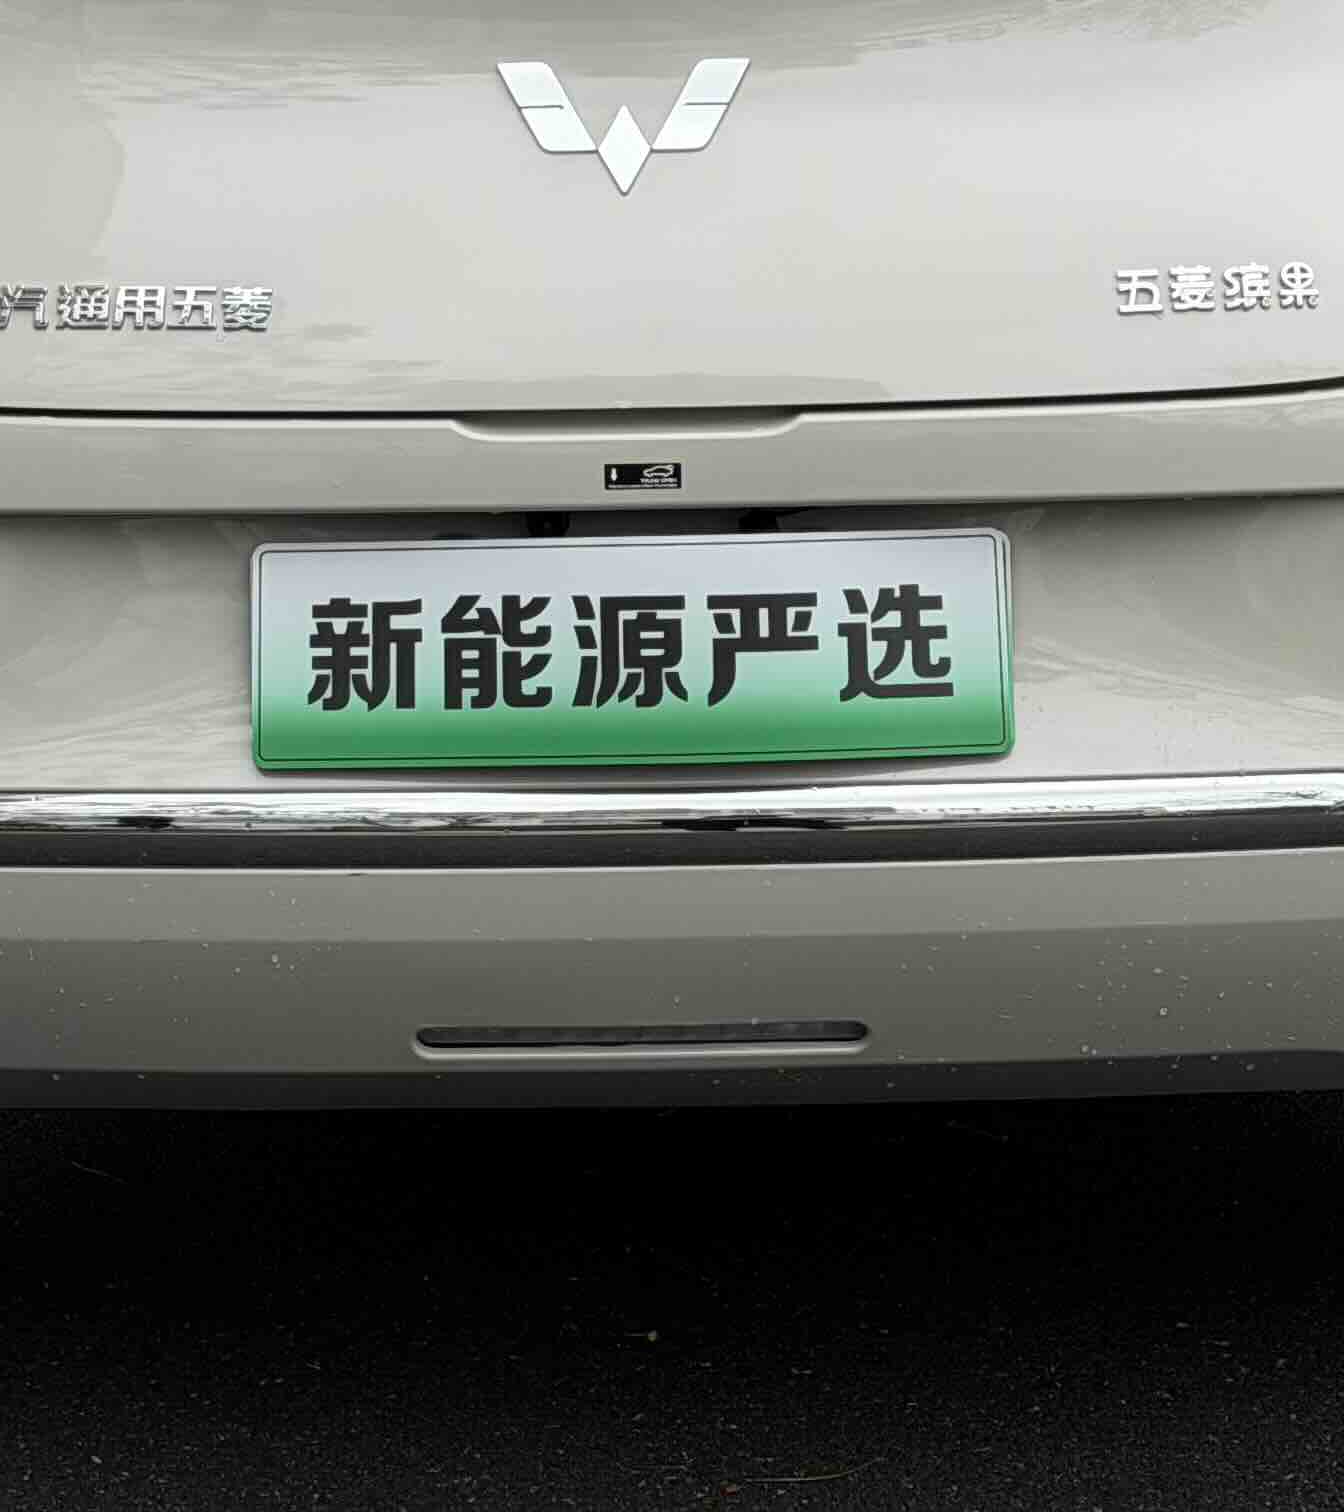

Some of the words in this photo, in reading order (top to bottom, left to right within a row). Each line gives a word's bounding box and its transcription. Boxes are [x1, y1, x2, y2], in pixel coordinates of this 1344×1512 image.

[1116, 261, 1321, 314] 五菱缤果
[307, 584, 954, 712] 新能源严选
